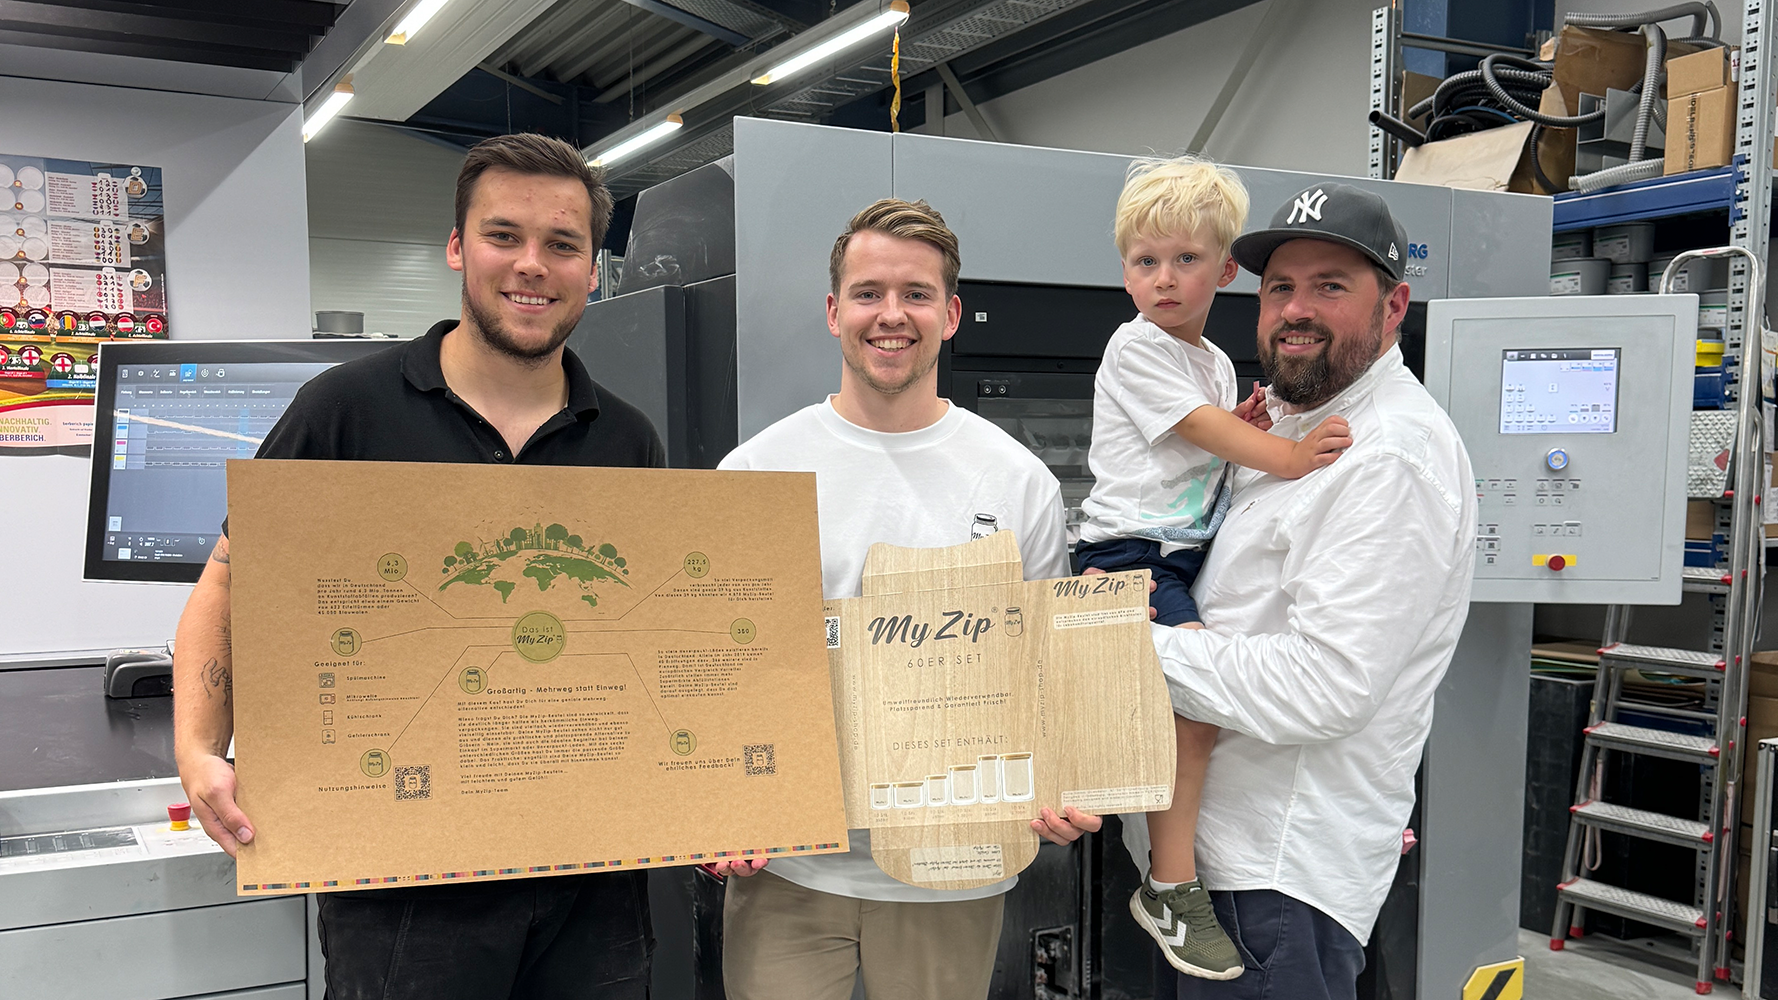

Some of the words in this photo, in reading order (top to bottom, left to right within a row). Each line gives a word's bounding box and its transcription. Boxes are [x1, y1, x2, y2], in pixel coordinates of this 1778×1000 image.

[1286, 188, 1328, 225] NY
[908, 657, 944, 668] 60ER
[957, 654, 982, 664] SET
[893, 740, 929, 750] DIESES
[934, 739, 951, 748] SET
[957, 735, 1008, 747] ENTHÄLT:
